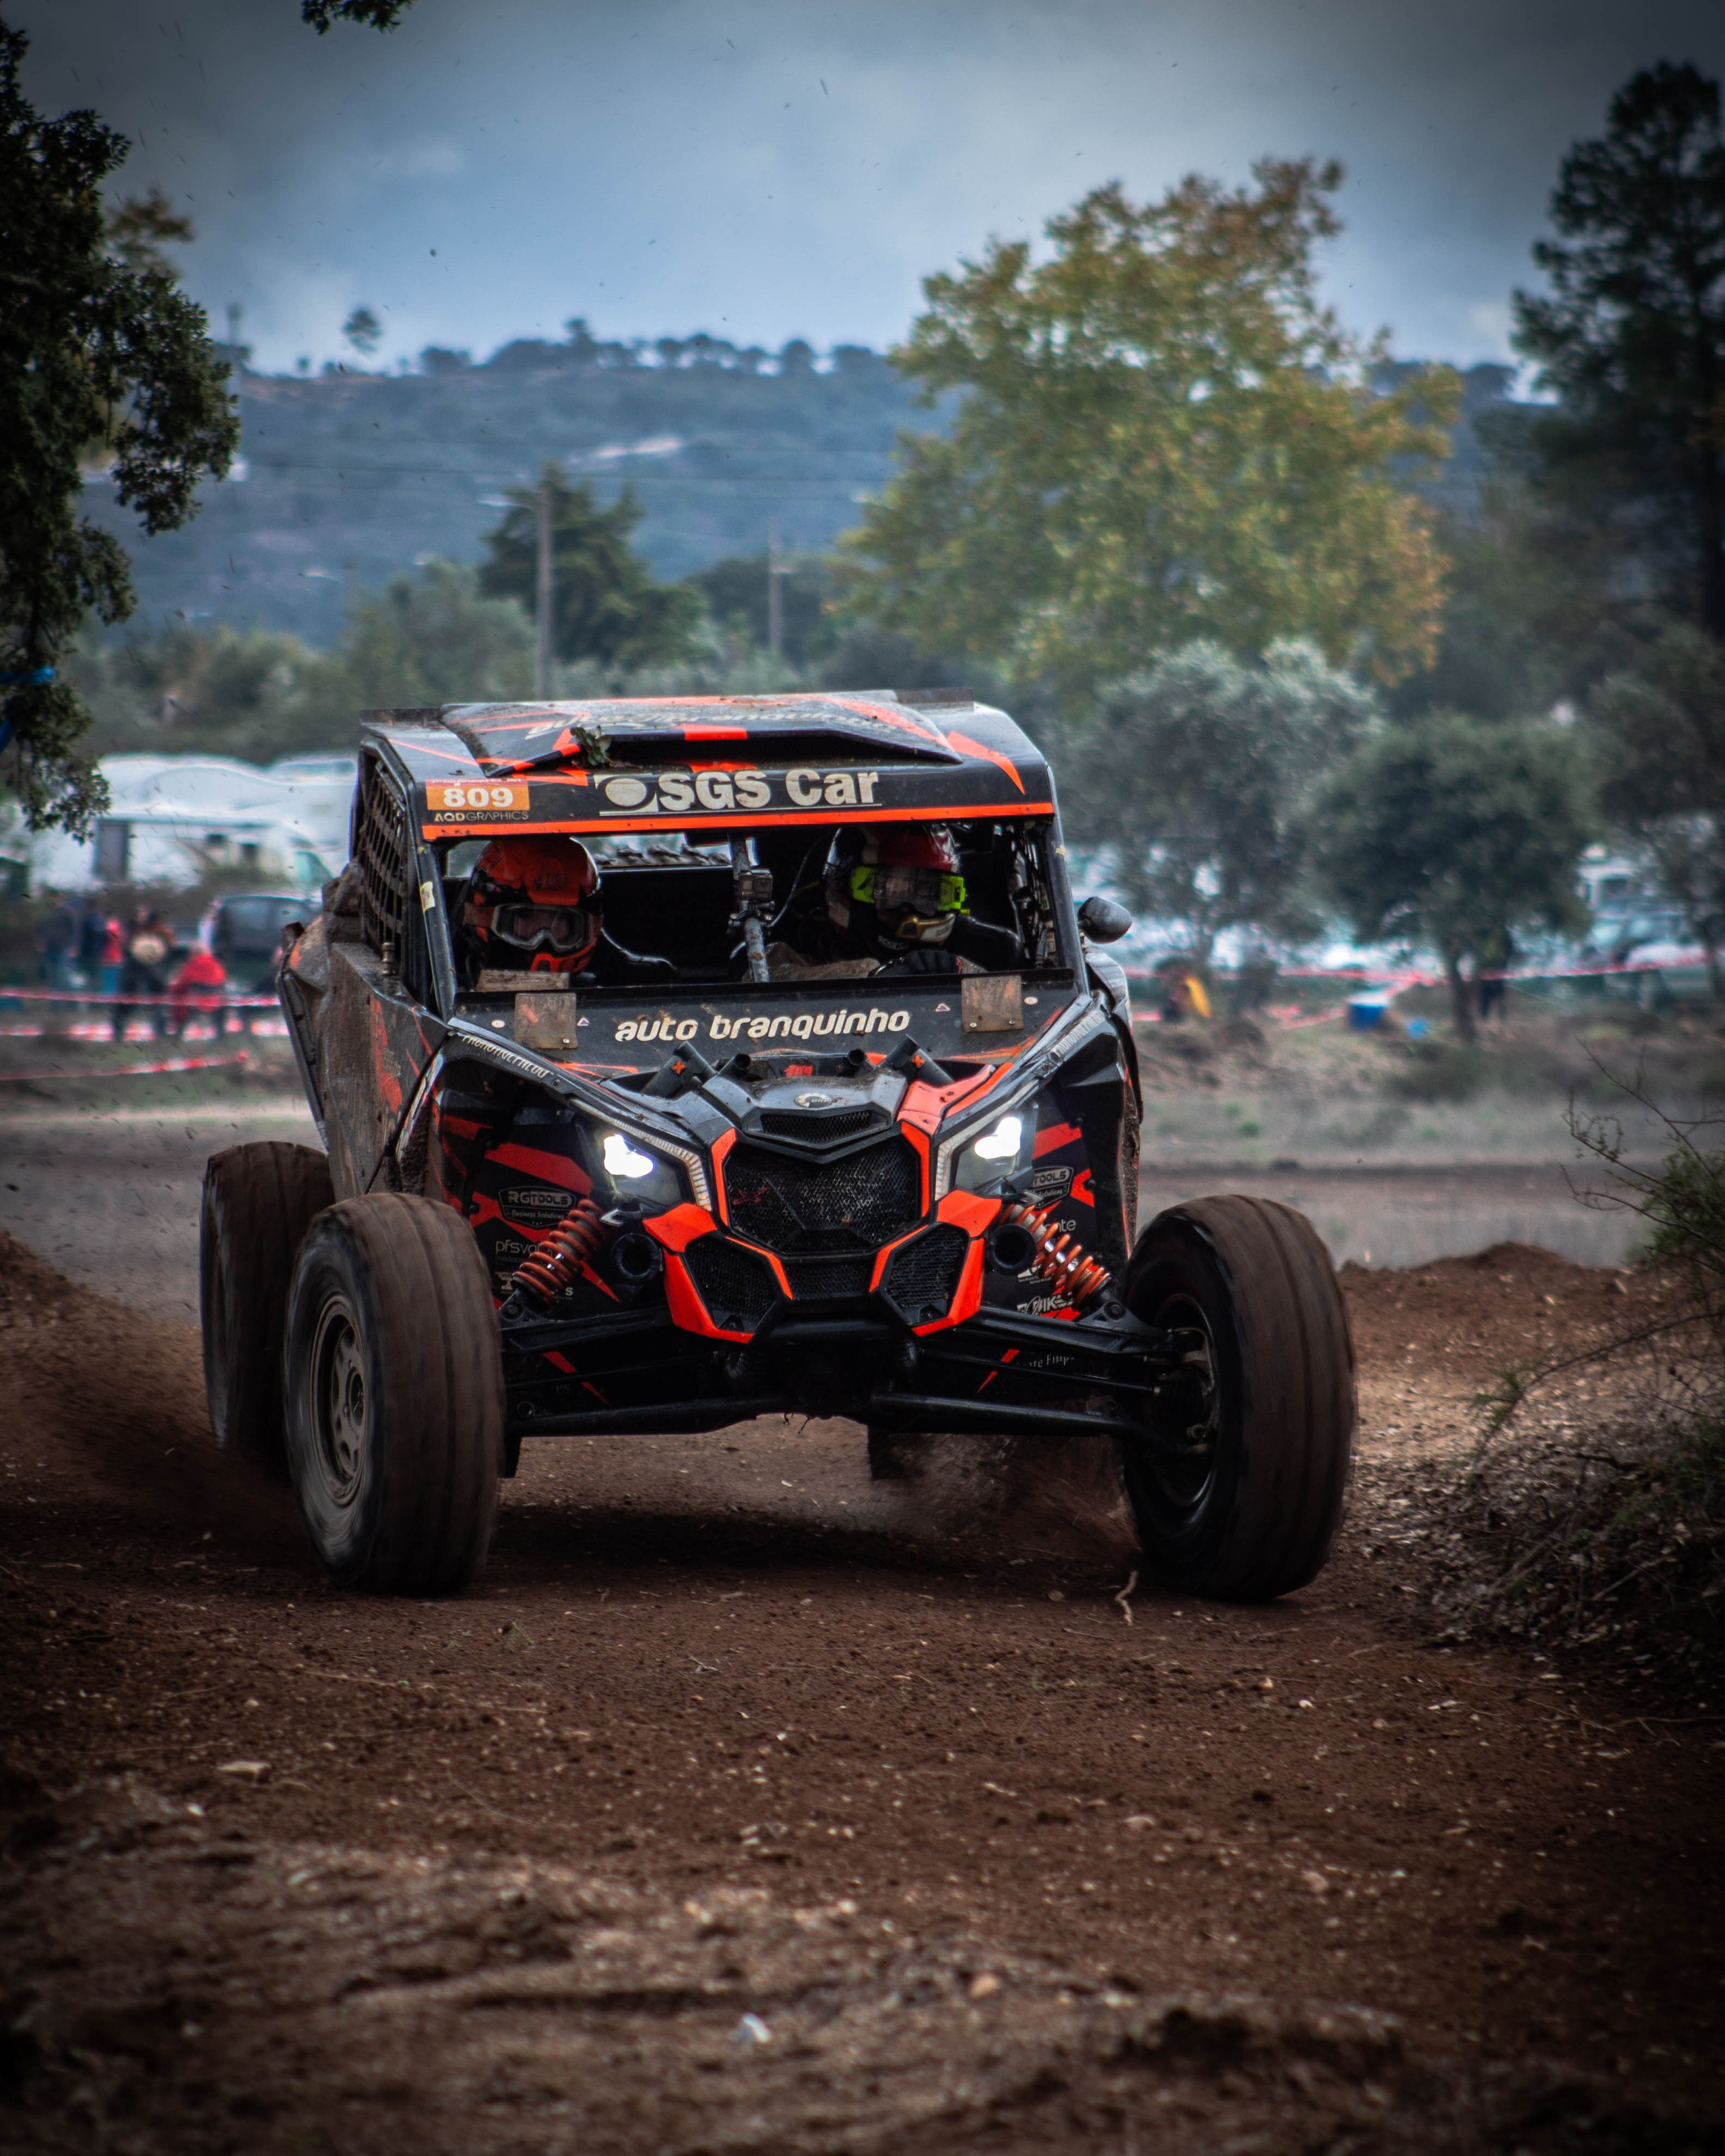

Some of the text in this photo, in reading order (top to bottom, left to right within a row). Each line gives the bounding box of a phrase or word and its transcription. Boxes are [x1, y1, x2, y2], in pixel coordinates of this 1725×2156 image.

[443, 787, 513, 808] 809
[658, 769, 879, 811] SGS Car
[615, 1009, 910, 1042] auto branquinho
